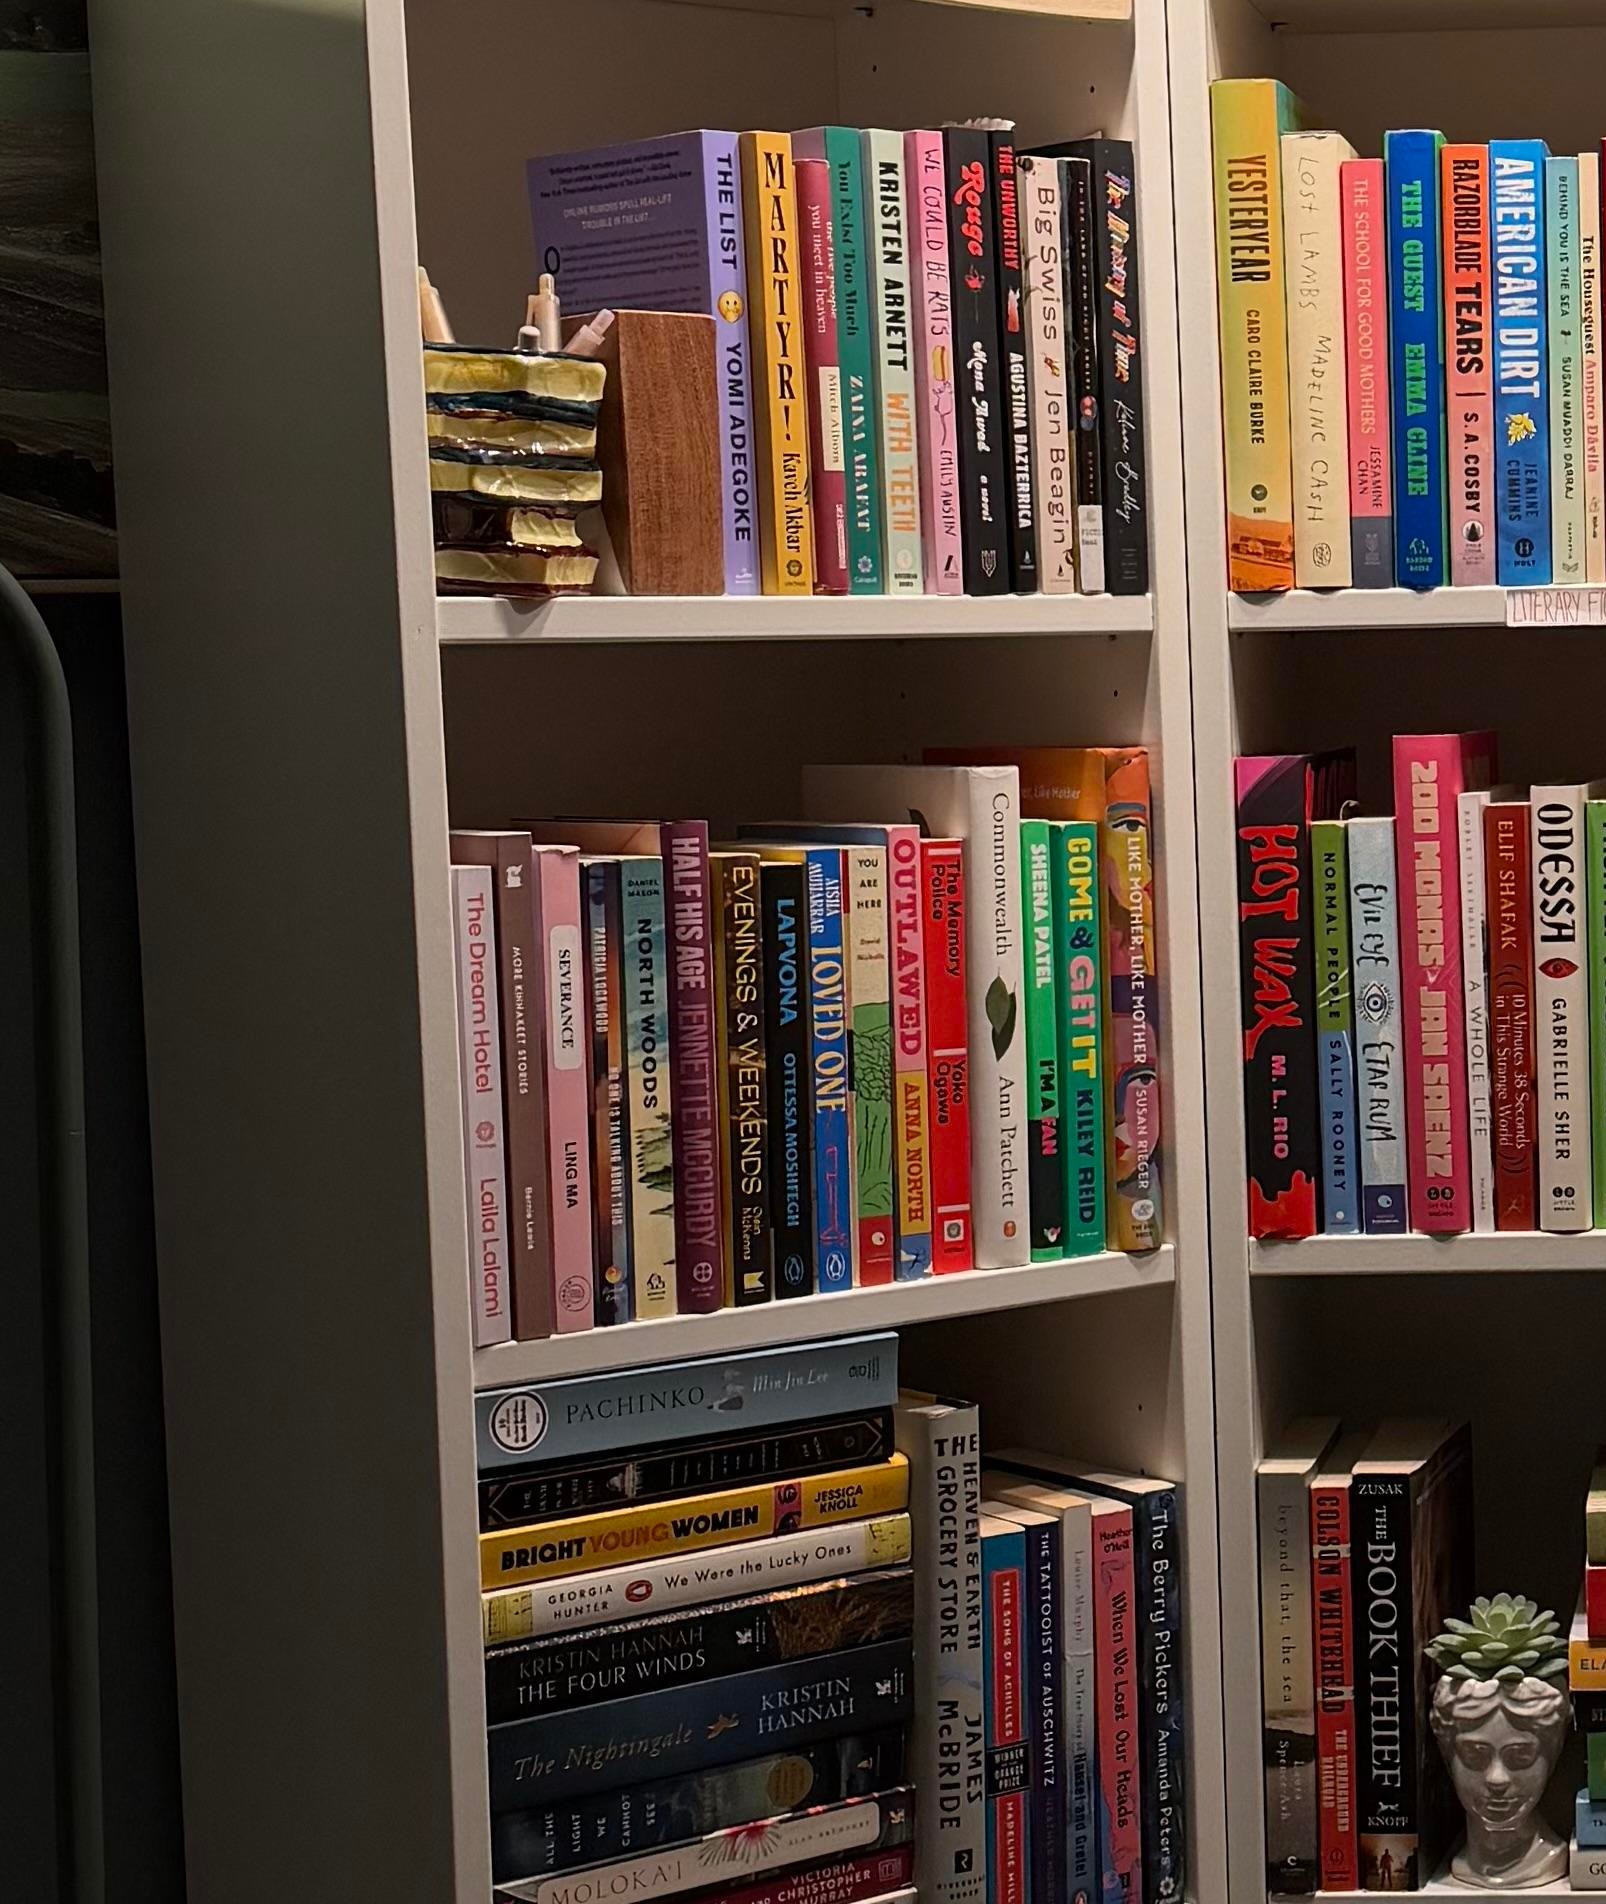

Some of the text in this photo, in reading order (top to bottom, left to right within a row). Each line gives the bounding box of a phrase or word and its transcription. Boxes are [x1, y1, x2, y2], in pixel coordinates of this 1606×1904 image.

[715, 154, 737, 269] THE LIST
[879, 162, 908, 370] KRISTEN ARNETT
[1036, 187, 1057, 338] Big Swiss
[1227, 155, 1270, 283] YESTERYEAR
[1401, 180, 1425, 311] THE GUEST
[1495, 156, 1539, 398] AMERICAN DIRT
[763, 152, 794, 442] MARTYR!
[892, 839, 922, 1055] OUTLAWED
[992, 792, 1009, 957] Commonwealth
[1239, 825, 1303, 1061] HOT WAX
[557, 949, 575, 1050] SEVERANCE
[776, 899, 798, 1026] LAPVONA
[811, 946, 846, 1112] LOVED ONE
[567, 1386, 695, 1424] PACHINKO
[500, 1505, 760, 1573] BRIGHT YOUNG WOMEN
[1358, 1482, 1403, 1496] ZUSAK
[1151, 1509, 1171, 1715] The Berry Pickers
